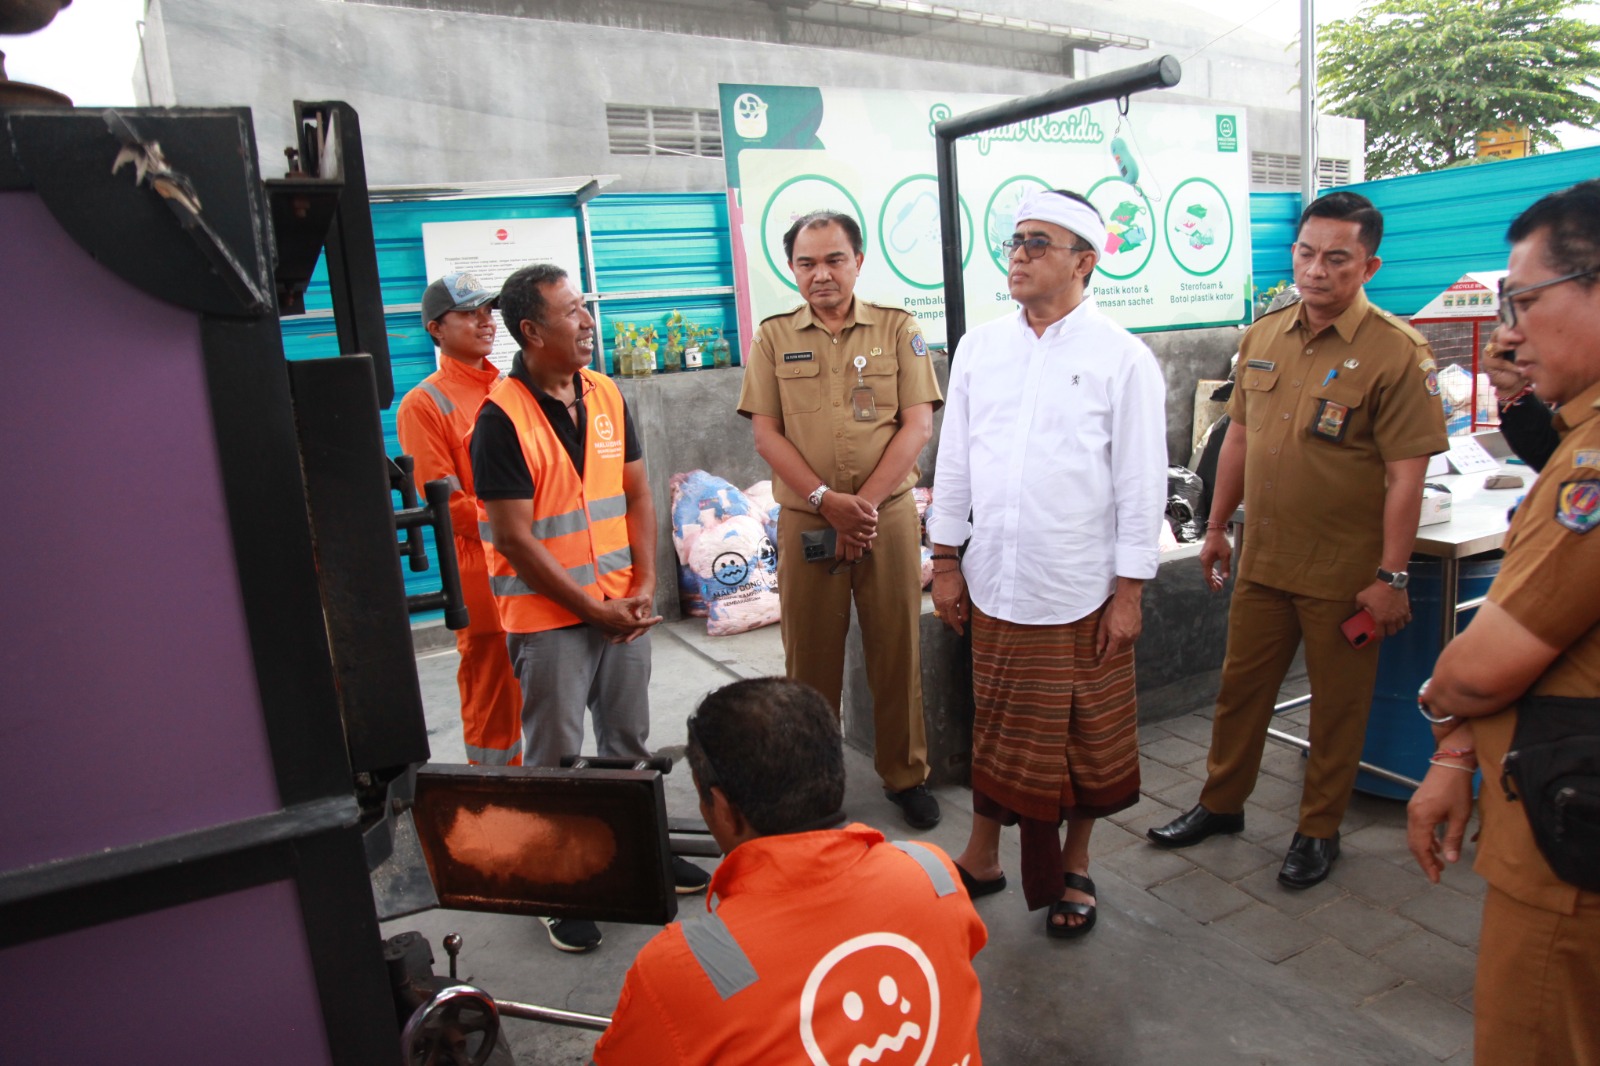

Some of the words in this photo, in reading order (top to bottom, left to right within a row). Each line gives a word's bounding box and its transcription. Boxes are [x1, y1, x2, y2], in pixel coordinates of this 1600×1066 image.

[1026, 107, 1104, 144] Residu
[1093, 287, 1120, 295] Plastik
[1122, 286, 1142, 294] kotor
[1143, 285, 1149, 293] &
[1180, 282, 1217, 291] Sterofoam
[1218, 281, 1223, 289] &
[904, 296, 945, 307] Pembalu
[1096, 299, 1126, 308] emasan
[1127, 297, 1153, 306] sachet
[1170, 294, 1189, 303] Botol
[1190, 293, 1214, 304] plastik
[1215, 293, 1234, 301] kotor
[911, 310, 944, 321] Pampe
[739, 580, 762, 592] DONG
